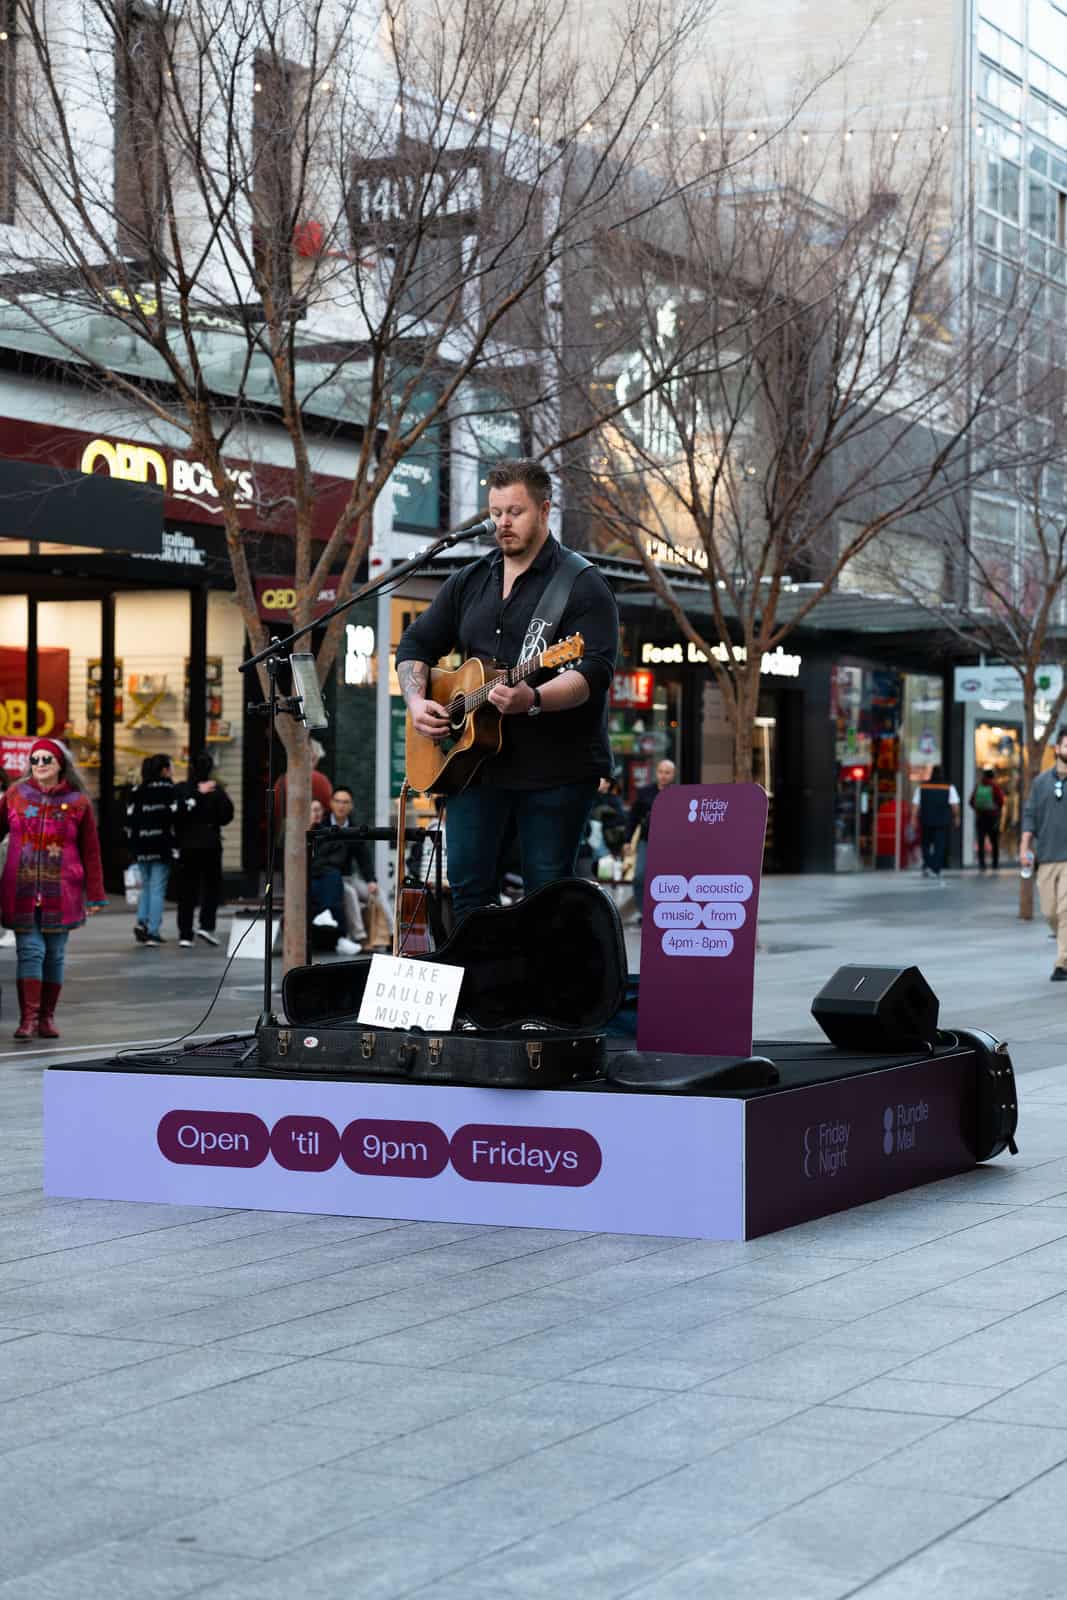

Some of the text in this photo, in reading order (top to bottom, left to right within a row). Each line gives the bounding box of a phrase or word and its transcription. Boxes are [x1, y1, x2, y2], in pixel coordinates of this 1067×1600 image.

[262, 589, 297, 609] QBD
[0, 699, 54, 736] BD
[702, 799, 729, 812] Friday
[700, 810, 725, 825] Night
[658, 881, 744, 894] Live acoustic
[661, 909, 737, 921] music from
[668, 936, 693, 950] 4pm
[701, 936, 728, 950] 8pm
[393, 963, 440, 983] JAKE
[375, 982, 448, 1007] DAULBY
[374, 1005, 435, 1029] MUSIC
[819, 1120, 851, 1149] Friday
[177, 1125, 579, 1173] Open 'til 9pm Fridays
[819, 1146, 848, 1176] Night
